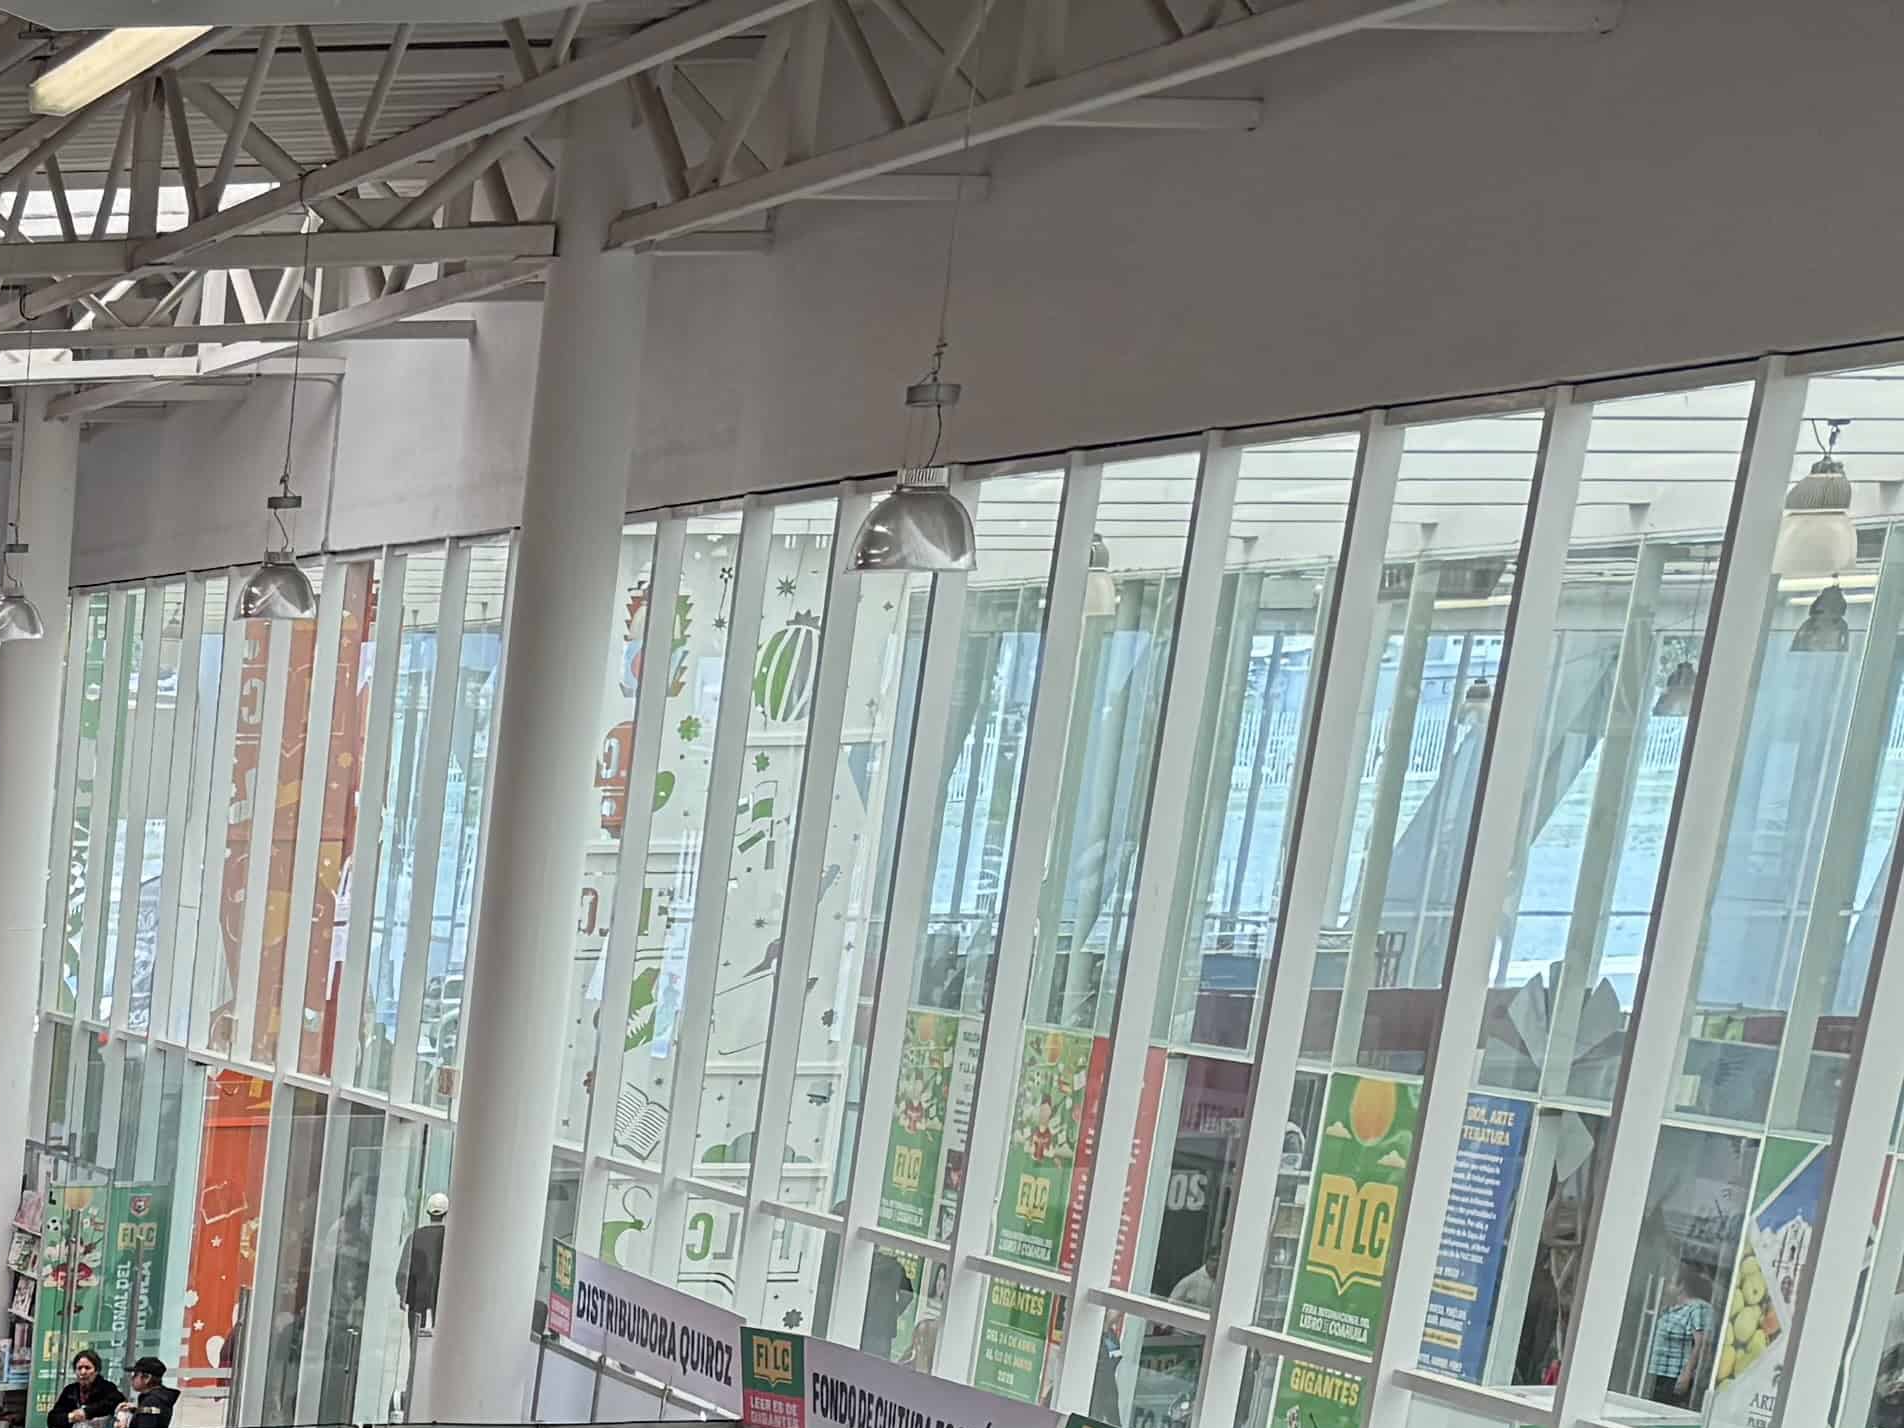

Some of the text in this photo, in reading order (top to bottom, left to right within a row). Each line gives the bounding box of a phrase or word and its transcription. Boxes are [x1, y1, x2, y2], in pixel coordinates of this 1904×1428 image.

[576, 1280, 733, 1387] DISTRIBUIDORA QUIROZ
[812, 1372, 857, 1428] FONDO
[1291, 1367, 1360, 1406] GIGANTES
